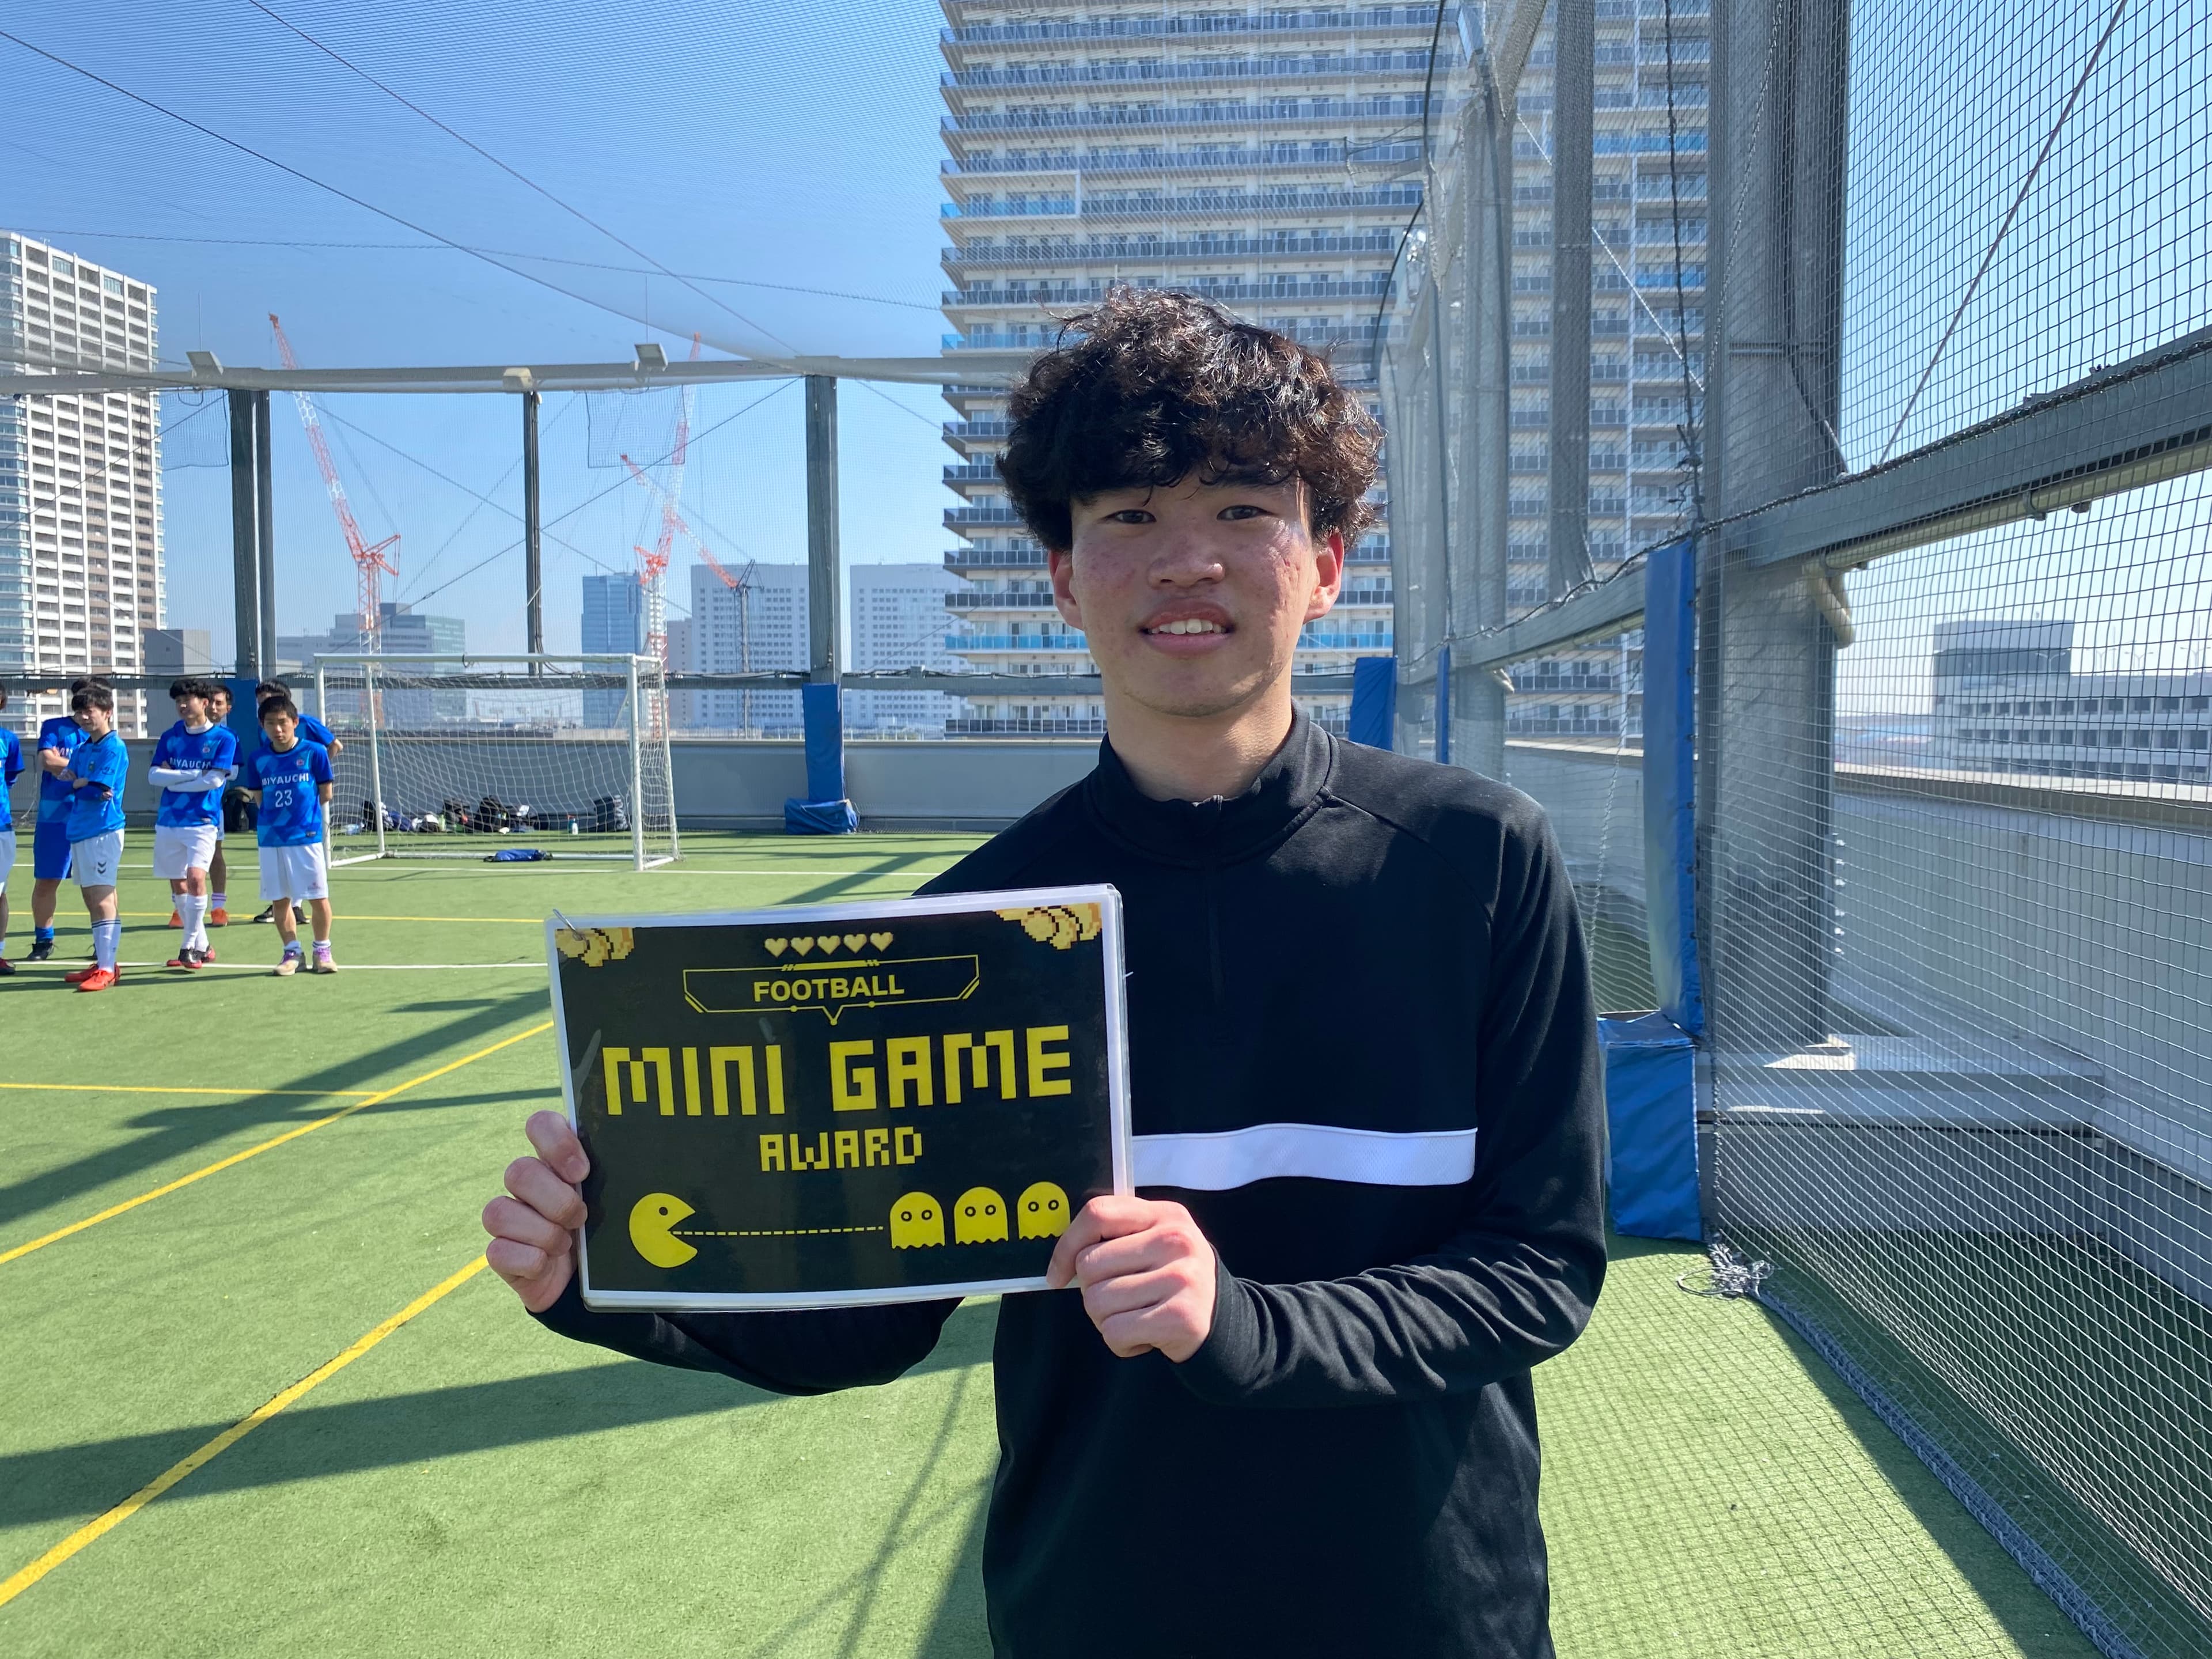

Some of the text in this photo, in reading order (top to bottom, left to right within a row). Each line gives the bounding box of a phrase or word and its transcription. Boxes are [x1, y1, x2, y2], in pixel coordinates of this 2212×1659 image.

[275, 789, 293, 808] 23
[753, 975, 904, 1002] FOOTBALL
[602, 1025, 1071, 1116] MINI GAME
[760, 1126, 922, 1172] AWARD
